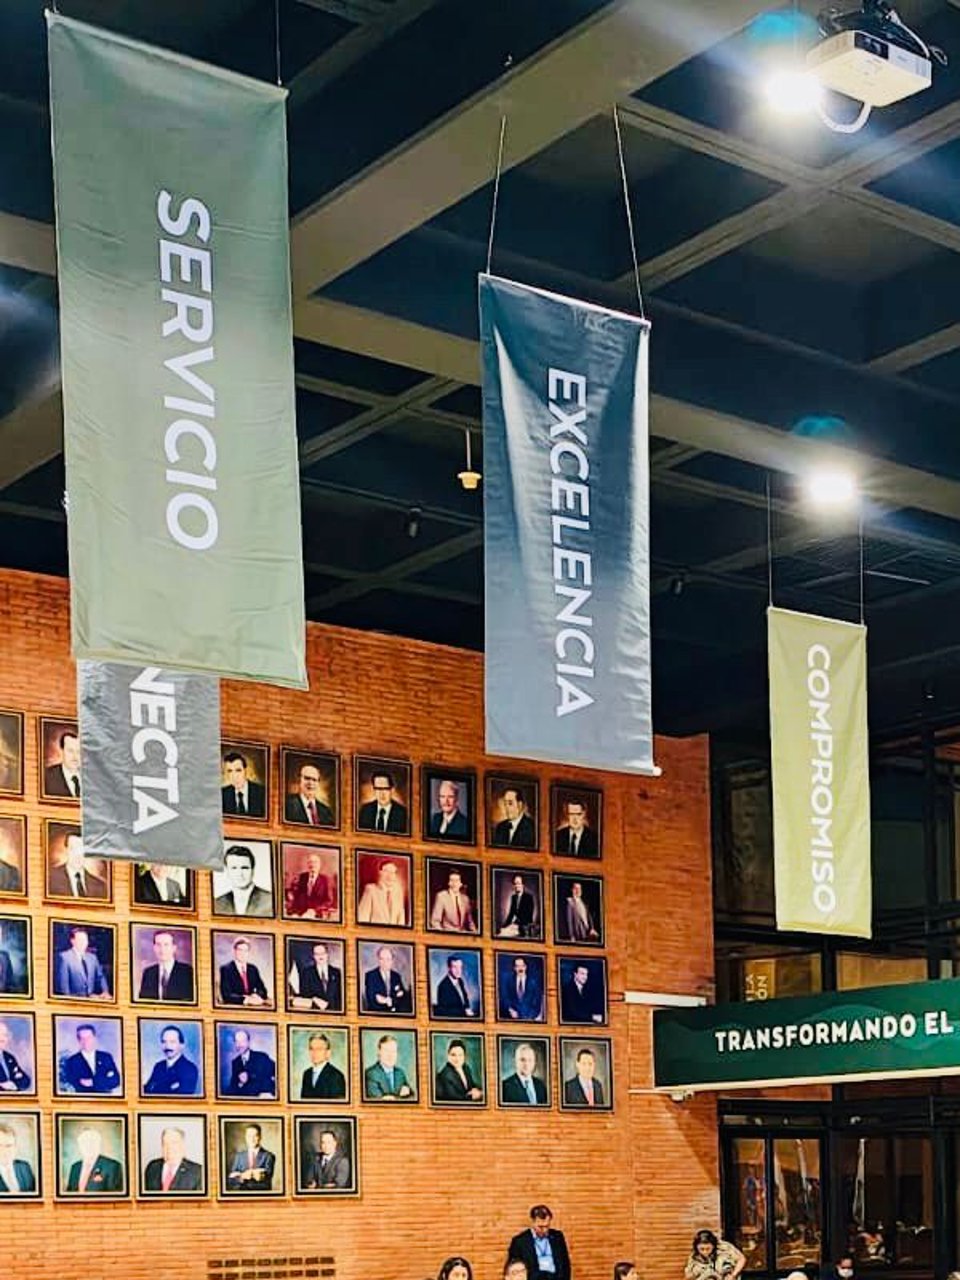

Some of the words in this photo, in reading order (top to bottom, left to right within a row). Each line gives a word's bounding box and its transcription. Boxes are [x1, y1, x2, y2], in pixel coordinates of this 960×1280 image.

[157, 189, 219, 552] SERVICIO
[547, 366, 597, 718] EXCELENCIA
[807, 643, 837, 914] COMPROMISO
[714, 1012, 917, 1053] TRANSFORMANDO
[924, 1010, 954, 1036] EL
